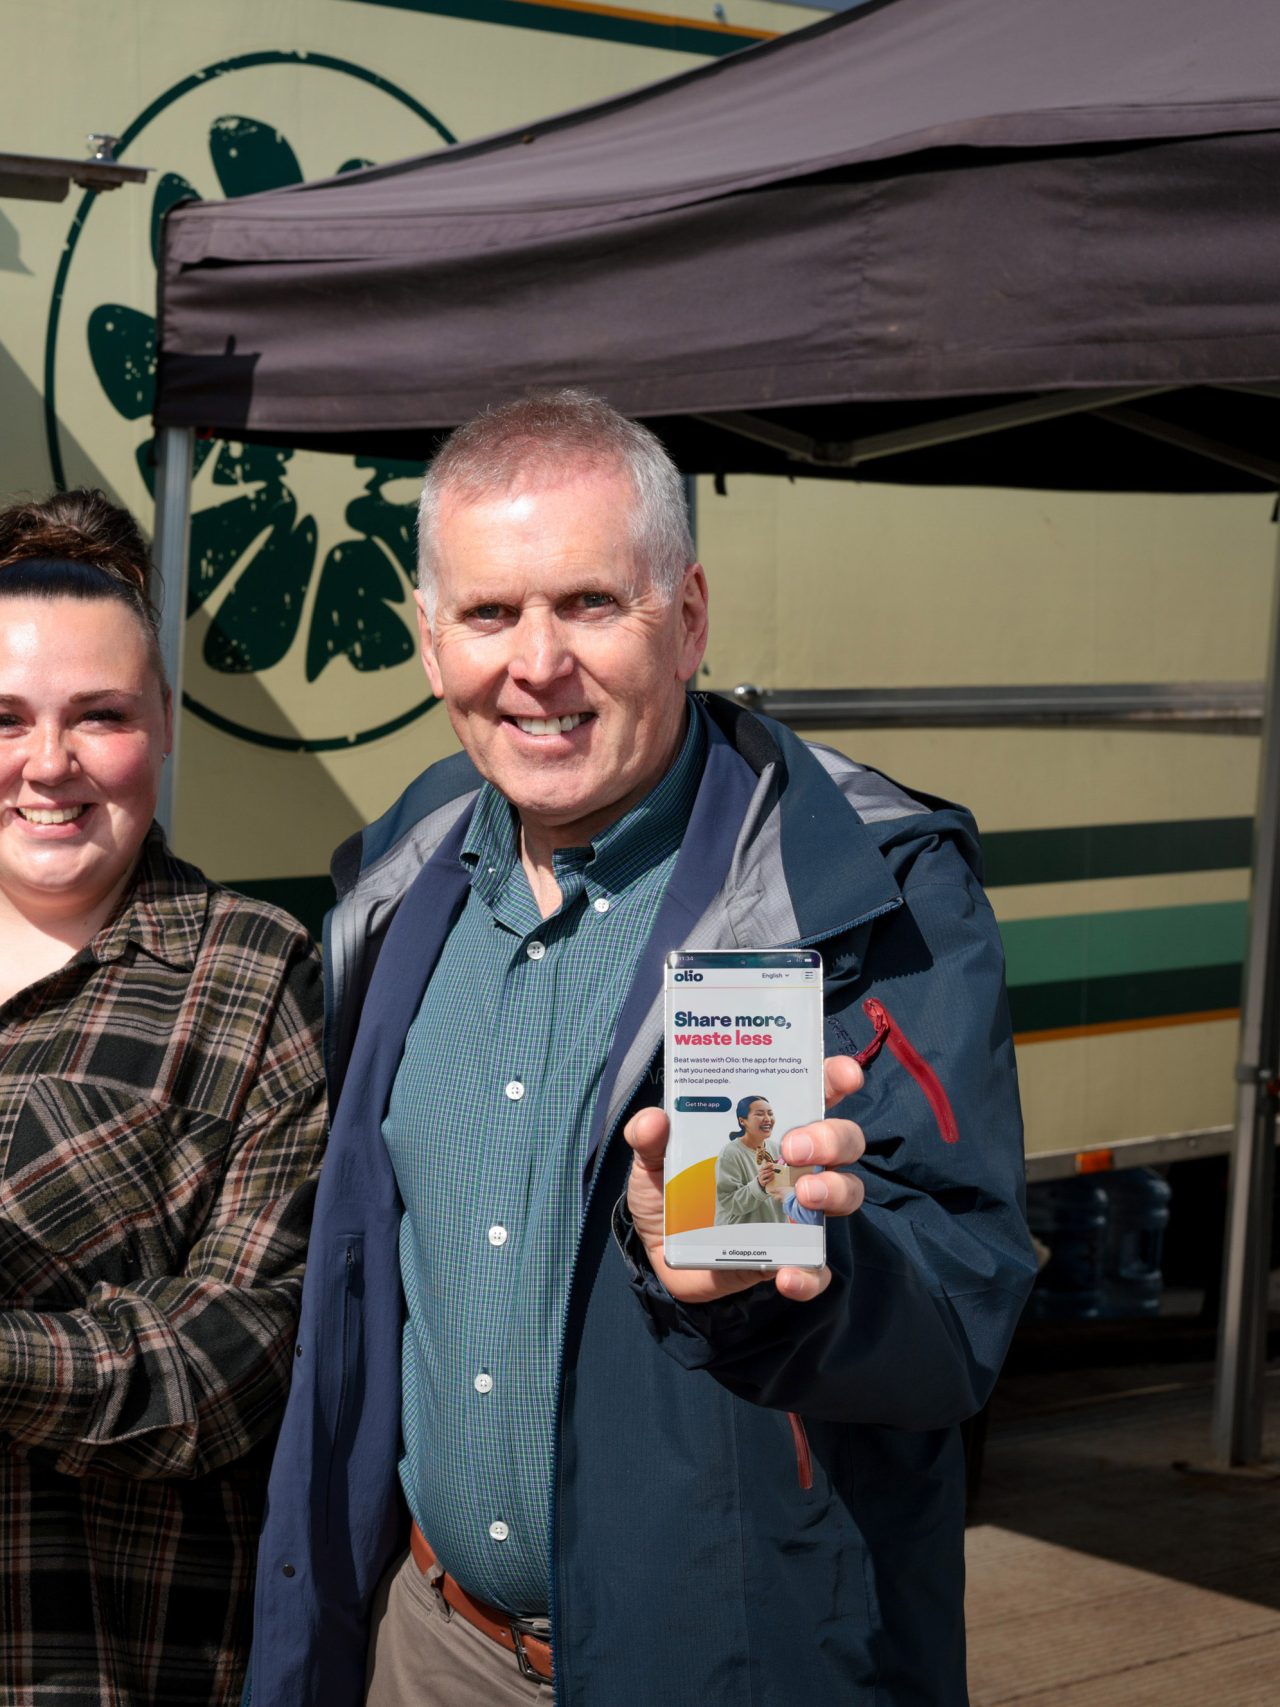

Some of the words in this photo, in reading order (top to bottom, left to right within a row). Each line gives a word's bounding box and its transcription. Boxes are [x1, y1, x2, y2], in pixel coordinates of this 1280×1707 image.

[674, 970, 704, 982] olio
[761, 972, 783, 980] English
[674, 1011, 732, 1027] Share
[735, 1015, 792, 1030] more,
[674, 1031, 732, 1046] waste
[735, 1029, 773, 1046] less
[673, 1056, 690, 1064] Beat
[709, 1056, 725, 1064] with
[725, 1056, 741, 1064] Olio:
[741, 1056, 753, 1064] the
[753, 1057, 768, 1065] app
[768, 1056, 778, 1064] for
[778, 1056, 802, 1065] finding
[735, 1067, 760, 1075] sharing
[704, 1077, 731, 1085] people.
